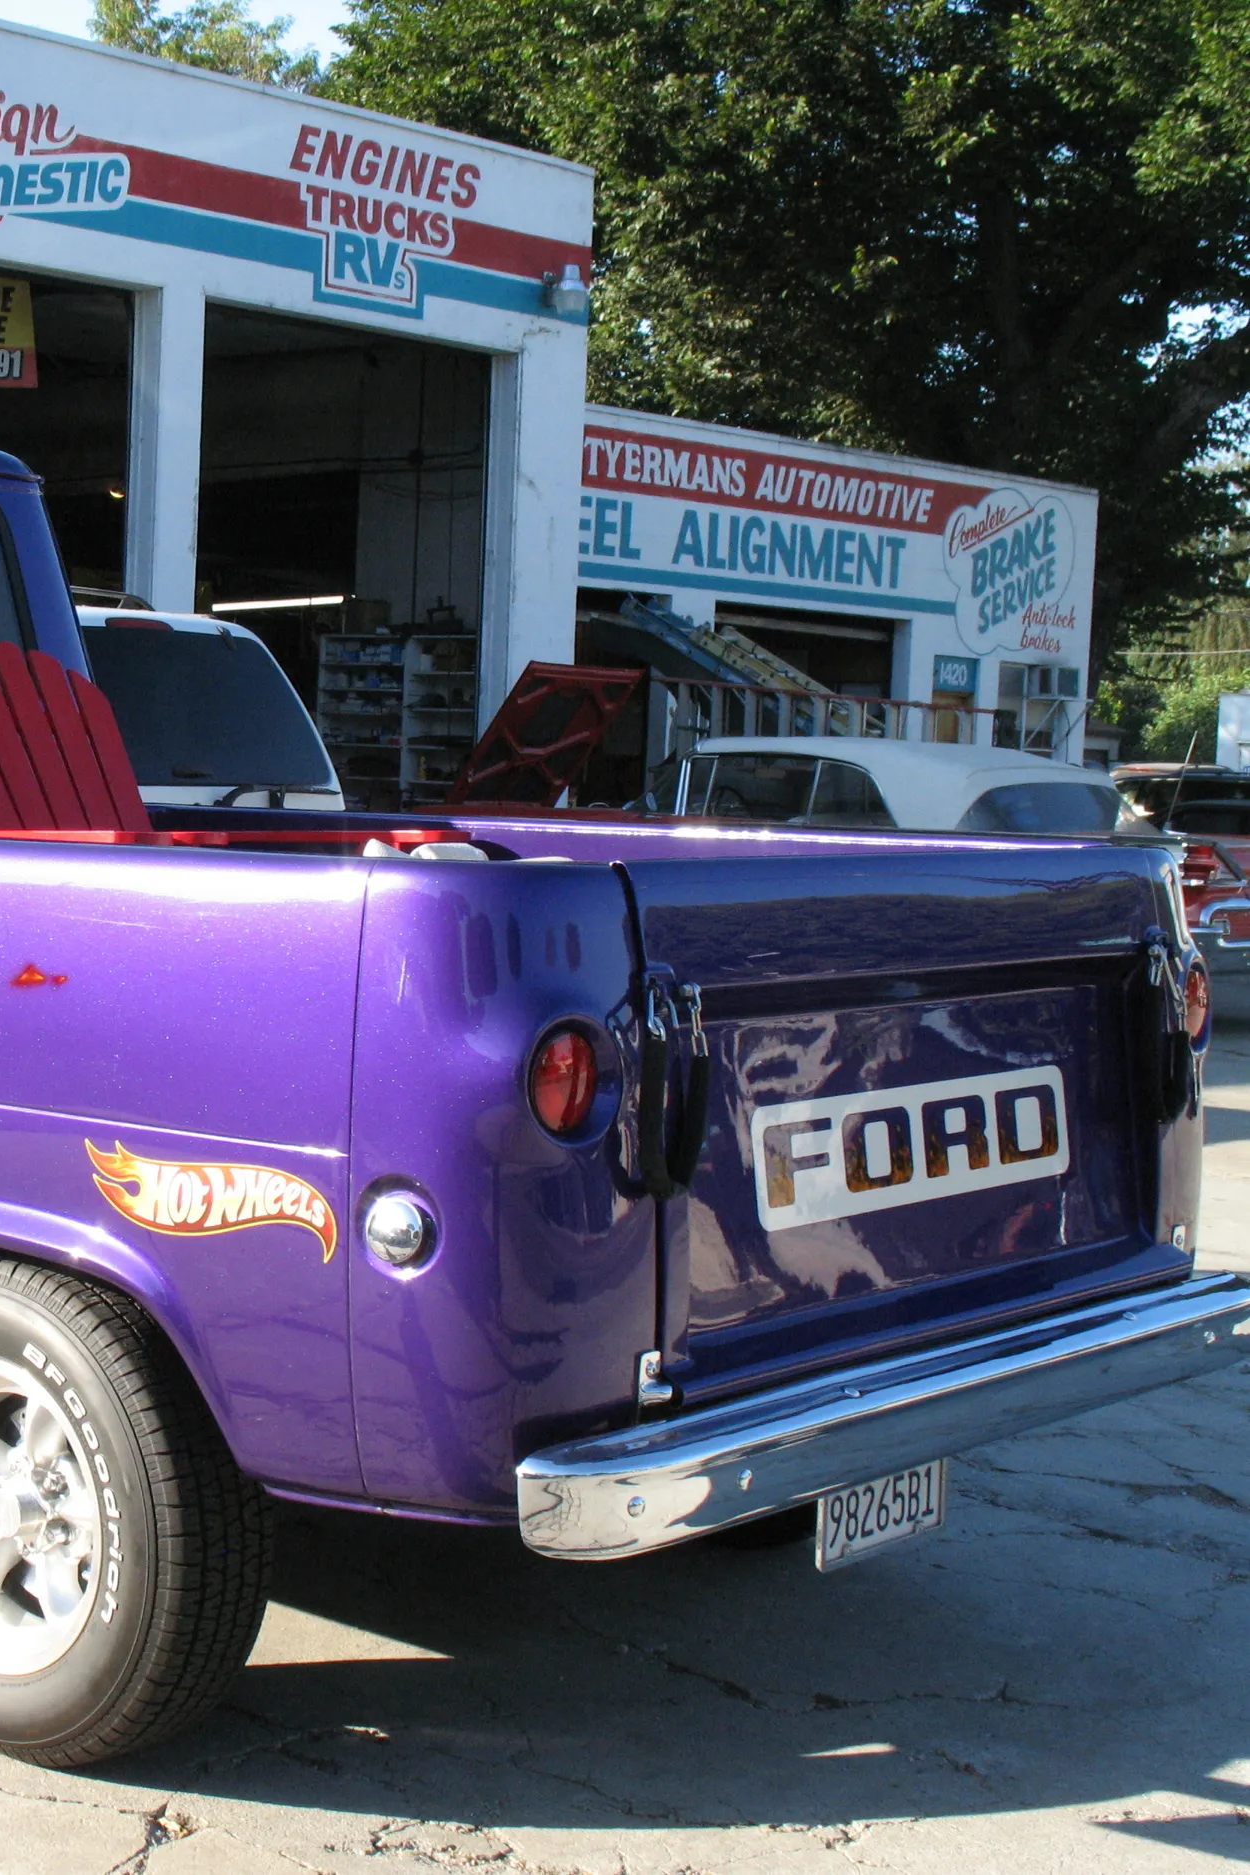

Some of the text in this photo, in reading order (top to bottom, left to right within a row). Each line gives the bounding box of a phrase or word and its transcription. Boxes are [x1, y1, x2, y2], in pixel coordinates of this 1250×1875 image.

[289, 124, 481, 208] ENGINES
[306, 185, 450, 248] TRUCKS
[334, 230, 405, 290] RVs
[584, 436, 935, 523] TYERMANS AUTOMOTIVE
[672, 508, 907, 589] ALIGNMENT
[949, 504, 1018, 559] Complete
[971, 508, 1057, 598] BRAKE
[977, 556, 1057, 634] SERVICE
[939, 662, 968, 687] 1420
[1019, 626, 1062, 653] brakes
[763, 1084, 1059, 1210] FORD
[829, 1465, 935, 1549] 98265B1
